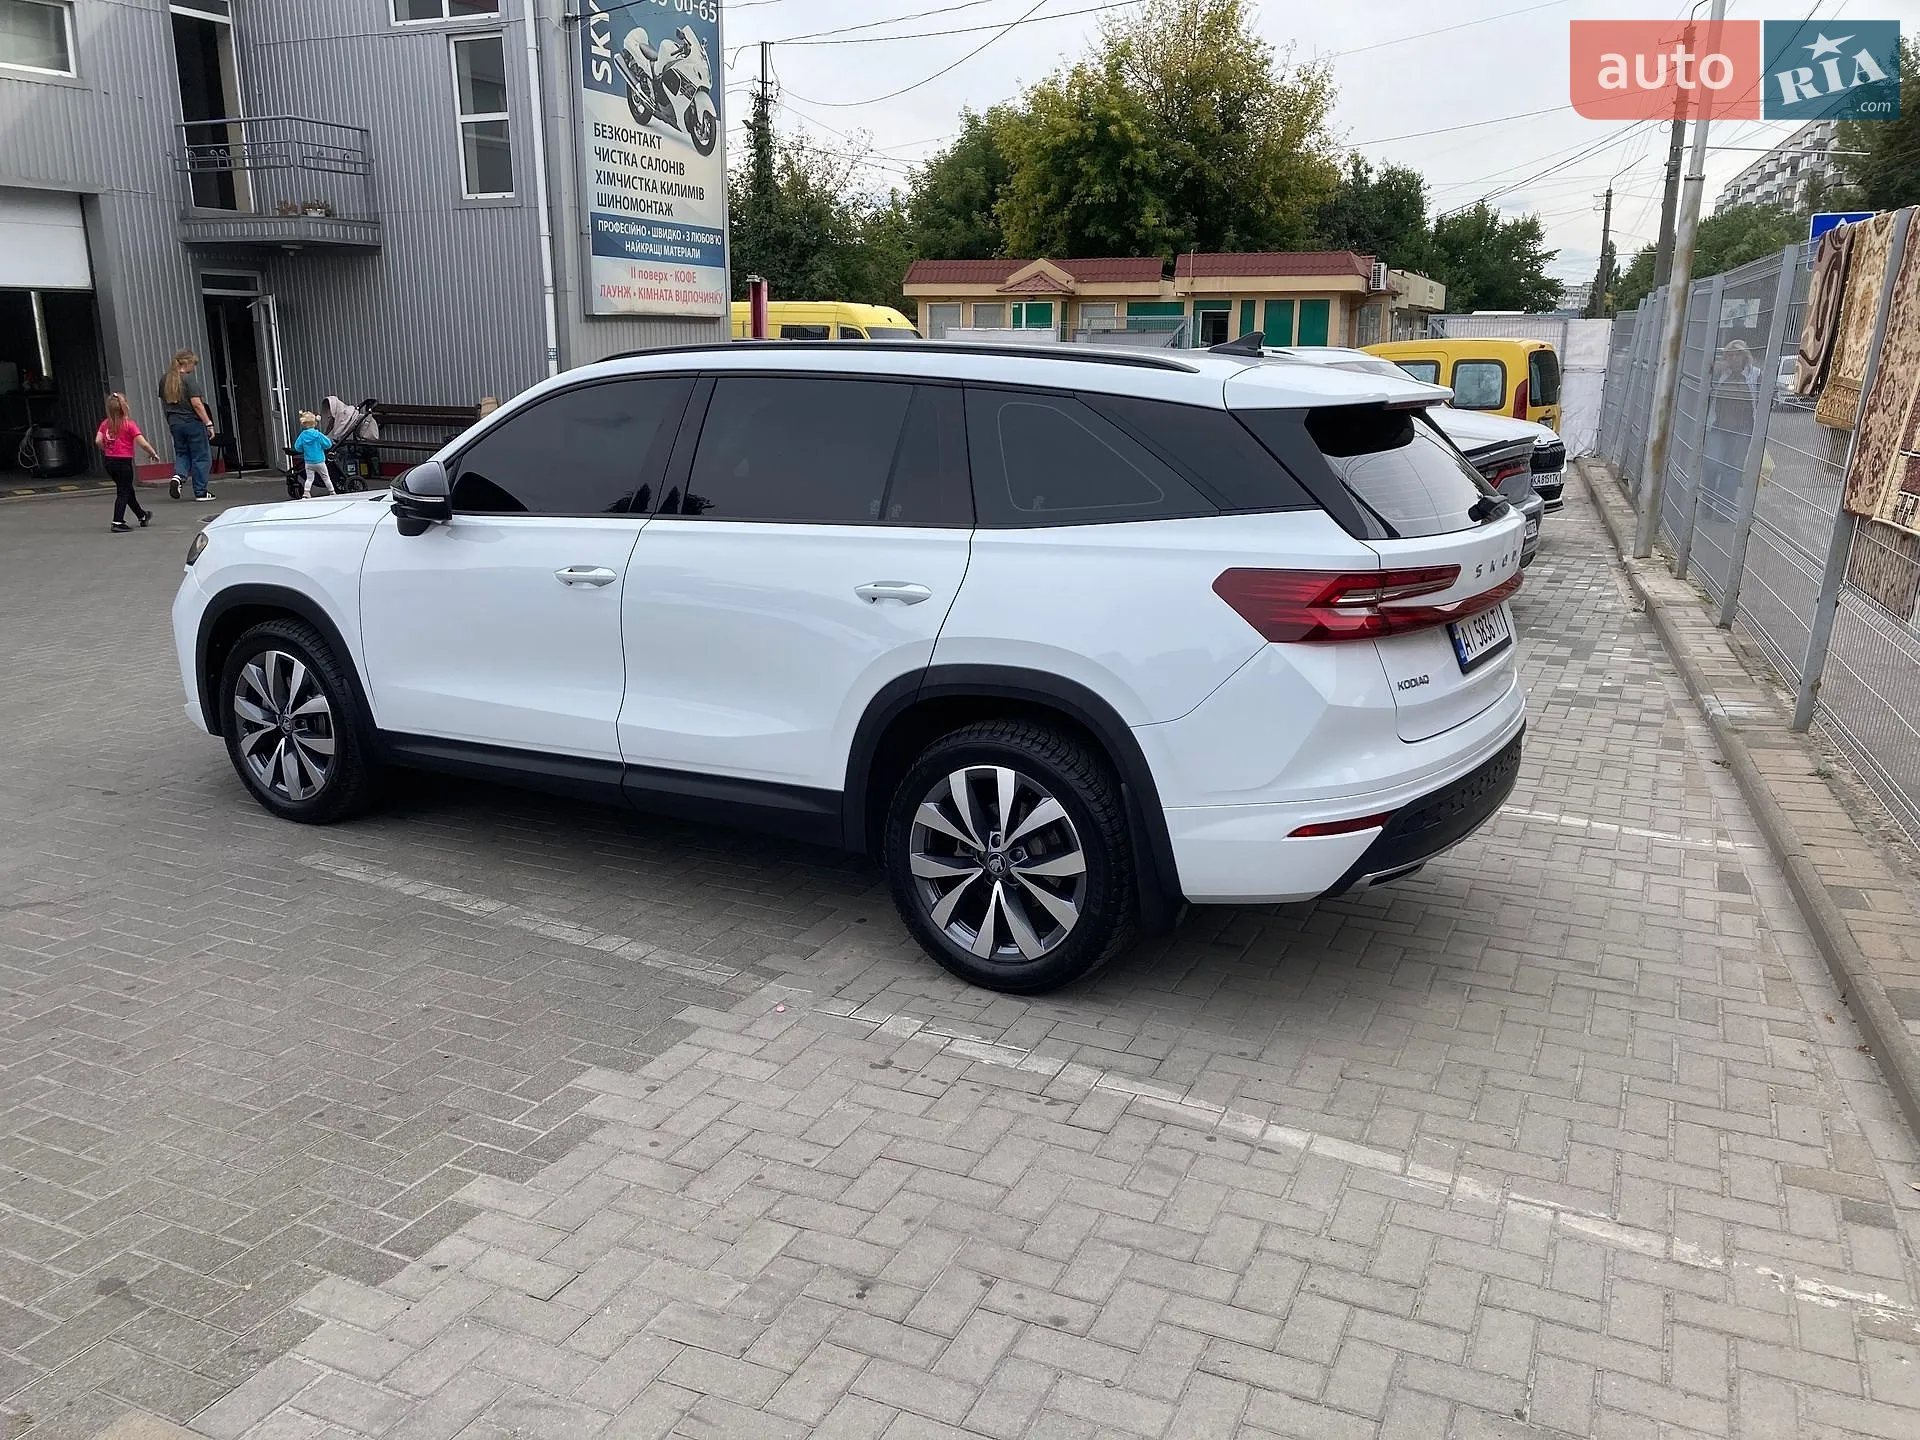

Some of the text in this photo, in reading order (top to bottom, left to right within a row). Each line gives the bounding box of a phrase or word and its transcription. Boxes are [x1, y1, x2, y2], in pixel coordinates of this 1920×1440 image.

[589, 0, 612, 85] SKY
[593, 122, 662, 150] БЕЗКОНТАКТ
[594, 145, 685, 176] ЧИСТКА САЛОНІВ
[595, 169, 705, 201] ХІМЧИСТКА КИЛИМІВ
[596, 192, 674, 217] ШИНОМОНТАЖ
[598, 219, 647, 237] ПРОФЕСІЙНО
[651, 226, 681, 241] ШВИДКО
[625, 239, 701, 259] НАЙКРАЩІ МАТЕРІАЛИ
[638, 270, 668, 284] поверх
[674, 270, 697, 284] КОФЕ
[600, 284, 724, 305] ЛАУНЖ КІМНАТА ВІДПОЧИНКУ
[1397, 674, 1430, 691] KODIAQ
